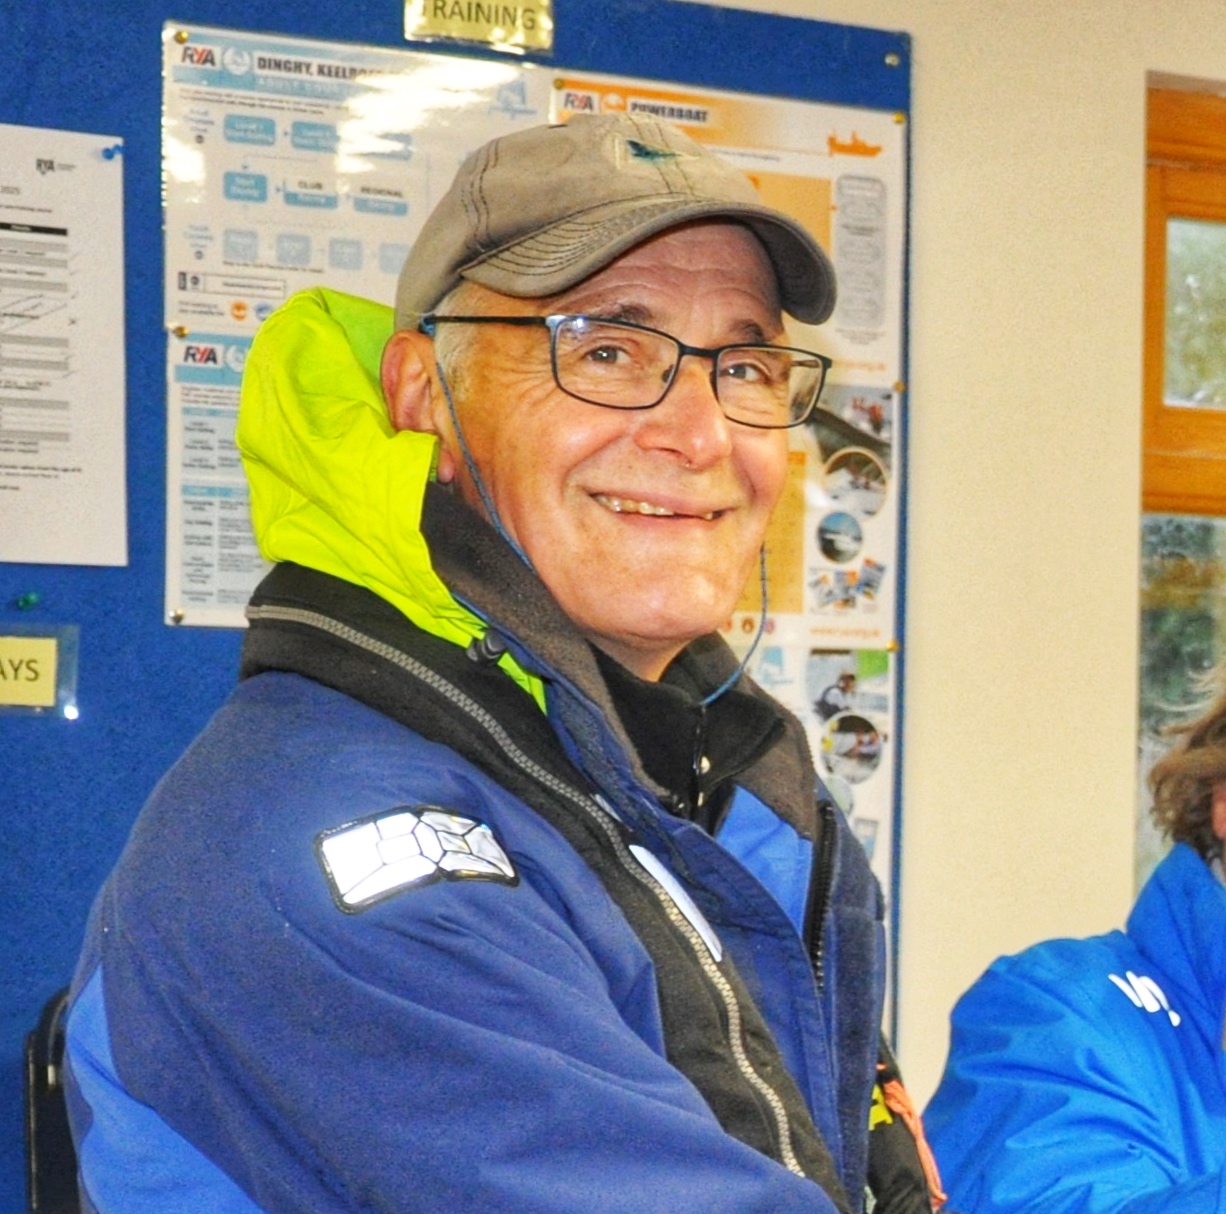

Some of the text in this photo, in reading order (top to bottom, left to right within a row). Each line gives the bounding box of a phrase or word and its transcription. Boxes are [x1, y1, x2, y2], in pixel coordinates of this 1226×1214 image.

[181, 46, 216, 66] RYA
[257, 57, 314, 76] DINGHY,
[563, 92, 594, 111] RYA
[630, 102, 709, 122] POWERBOAT
[183, 346, 218, 365] RYA
